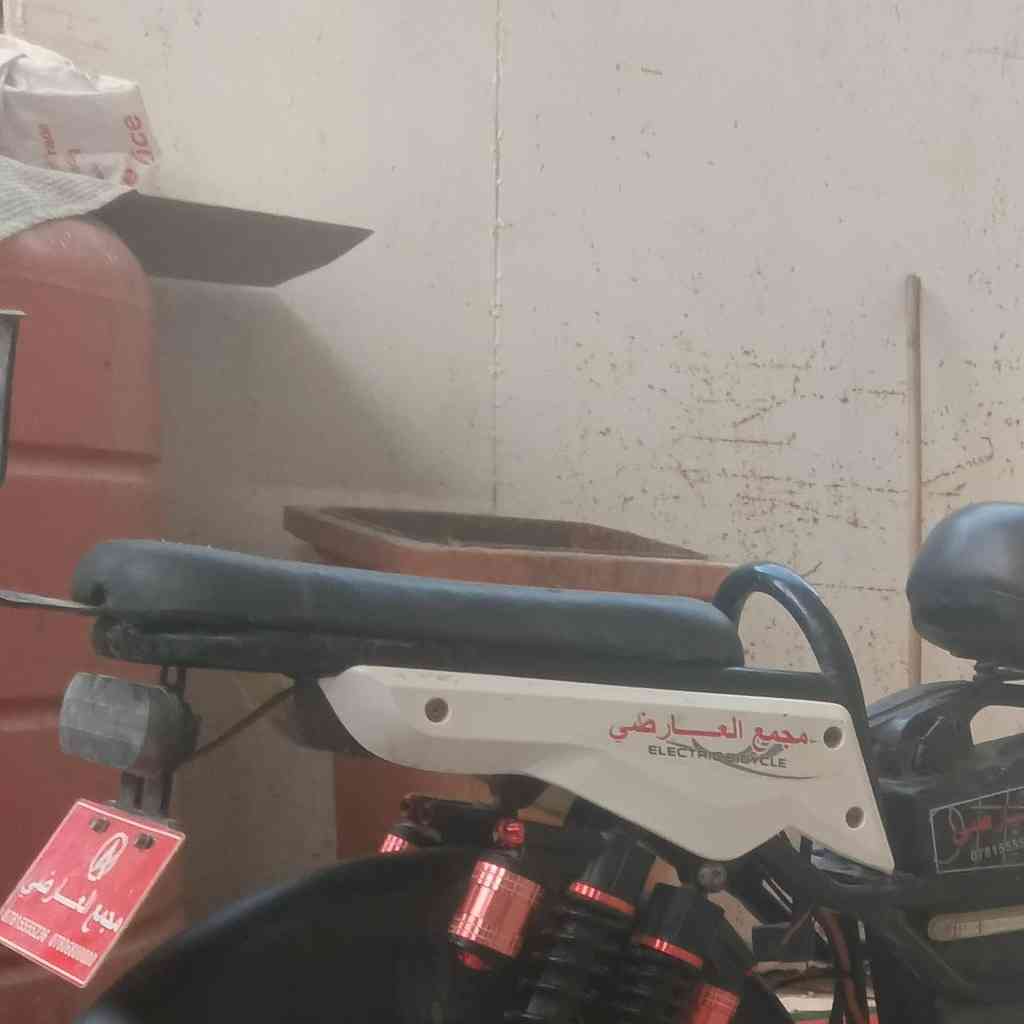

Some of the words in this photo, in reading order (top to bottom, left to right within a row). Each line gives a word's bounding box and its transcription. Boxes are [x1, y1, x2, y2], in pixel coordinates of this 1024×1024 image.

[752, 726, 809, 753] مجمع
[648, 743, 722, 762] ELECTRIC
[724, 750, 788, 768] BICYCLE
